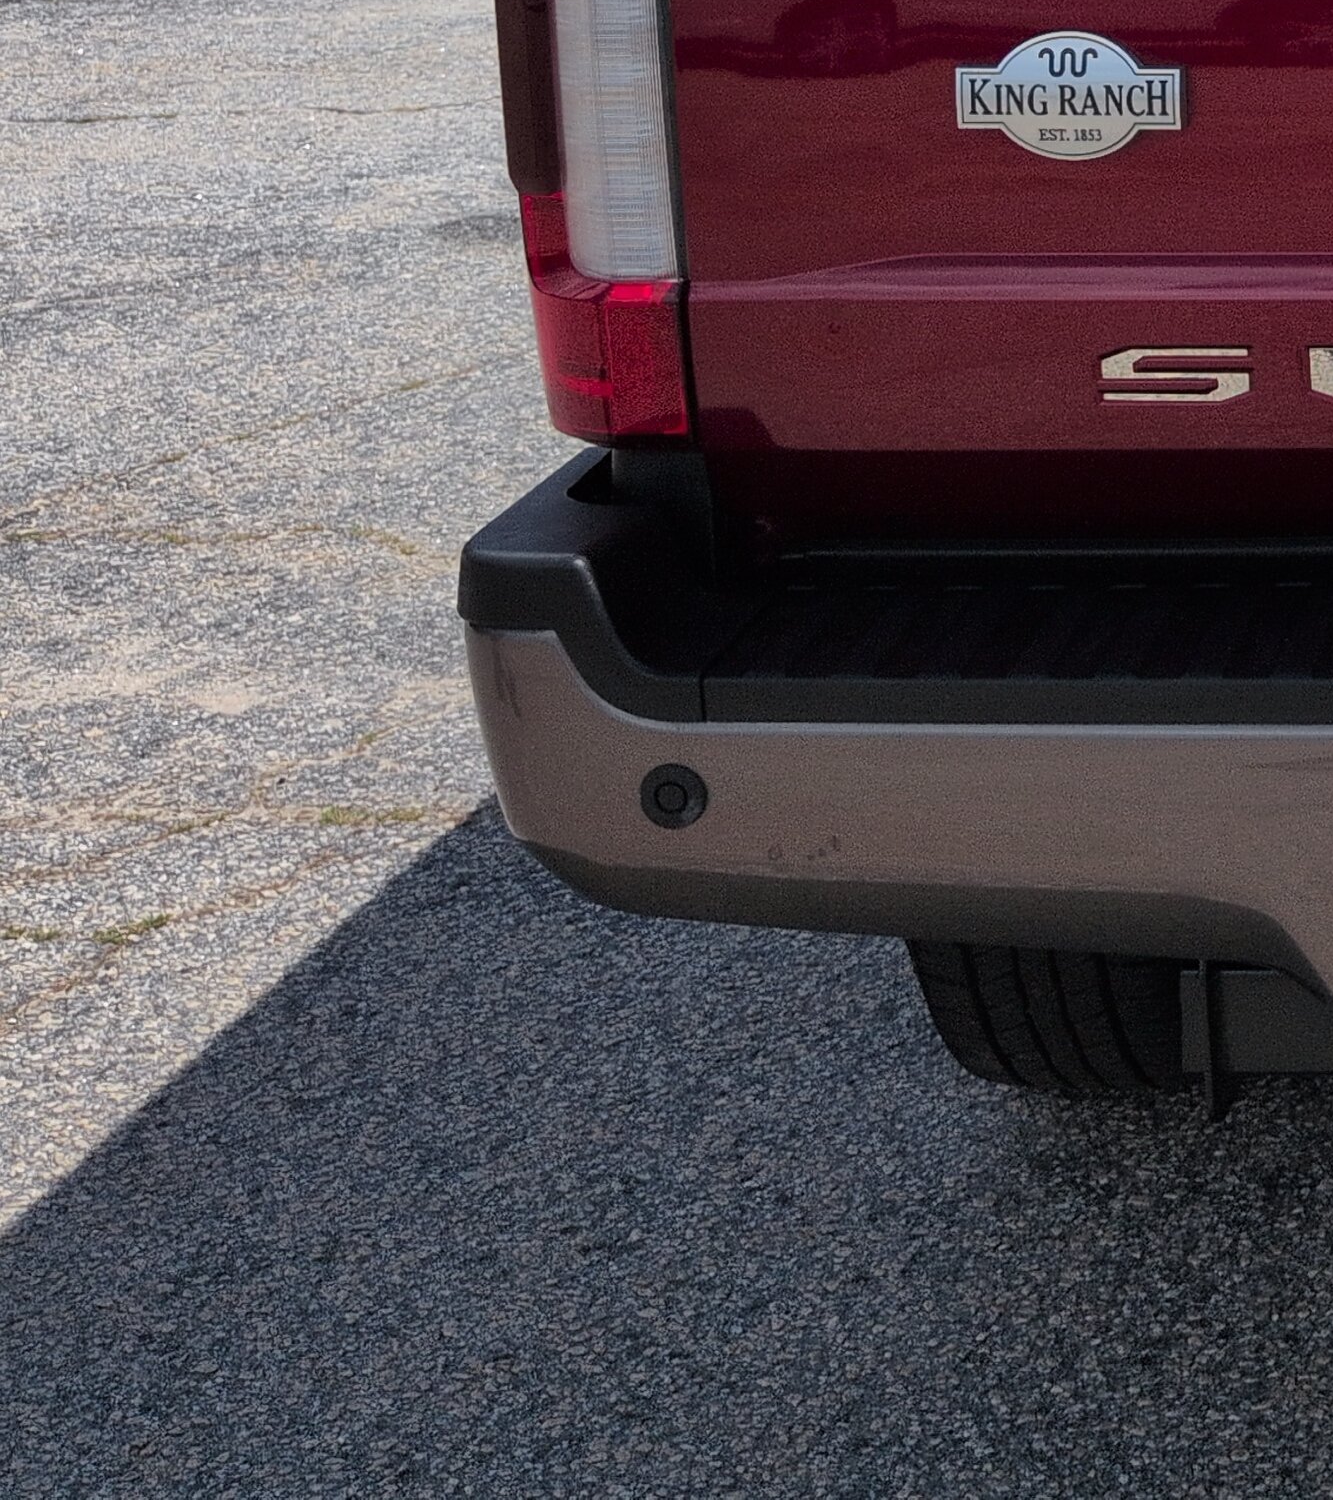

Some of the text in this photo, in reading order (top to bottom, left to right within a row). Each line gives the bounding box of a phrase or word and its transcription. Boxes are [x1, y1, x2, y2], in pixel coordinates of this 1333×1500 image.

[968, 78, 1170, 117] KING RANCH
[1038, 128, 1103, 142] EST. 1853
